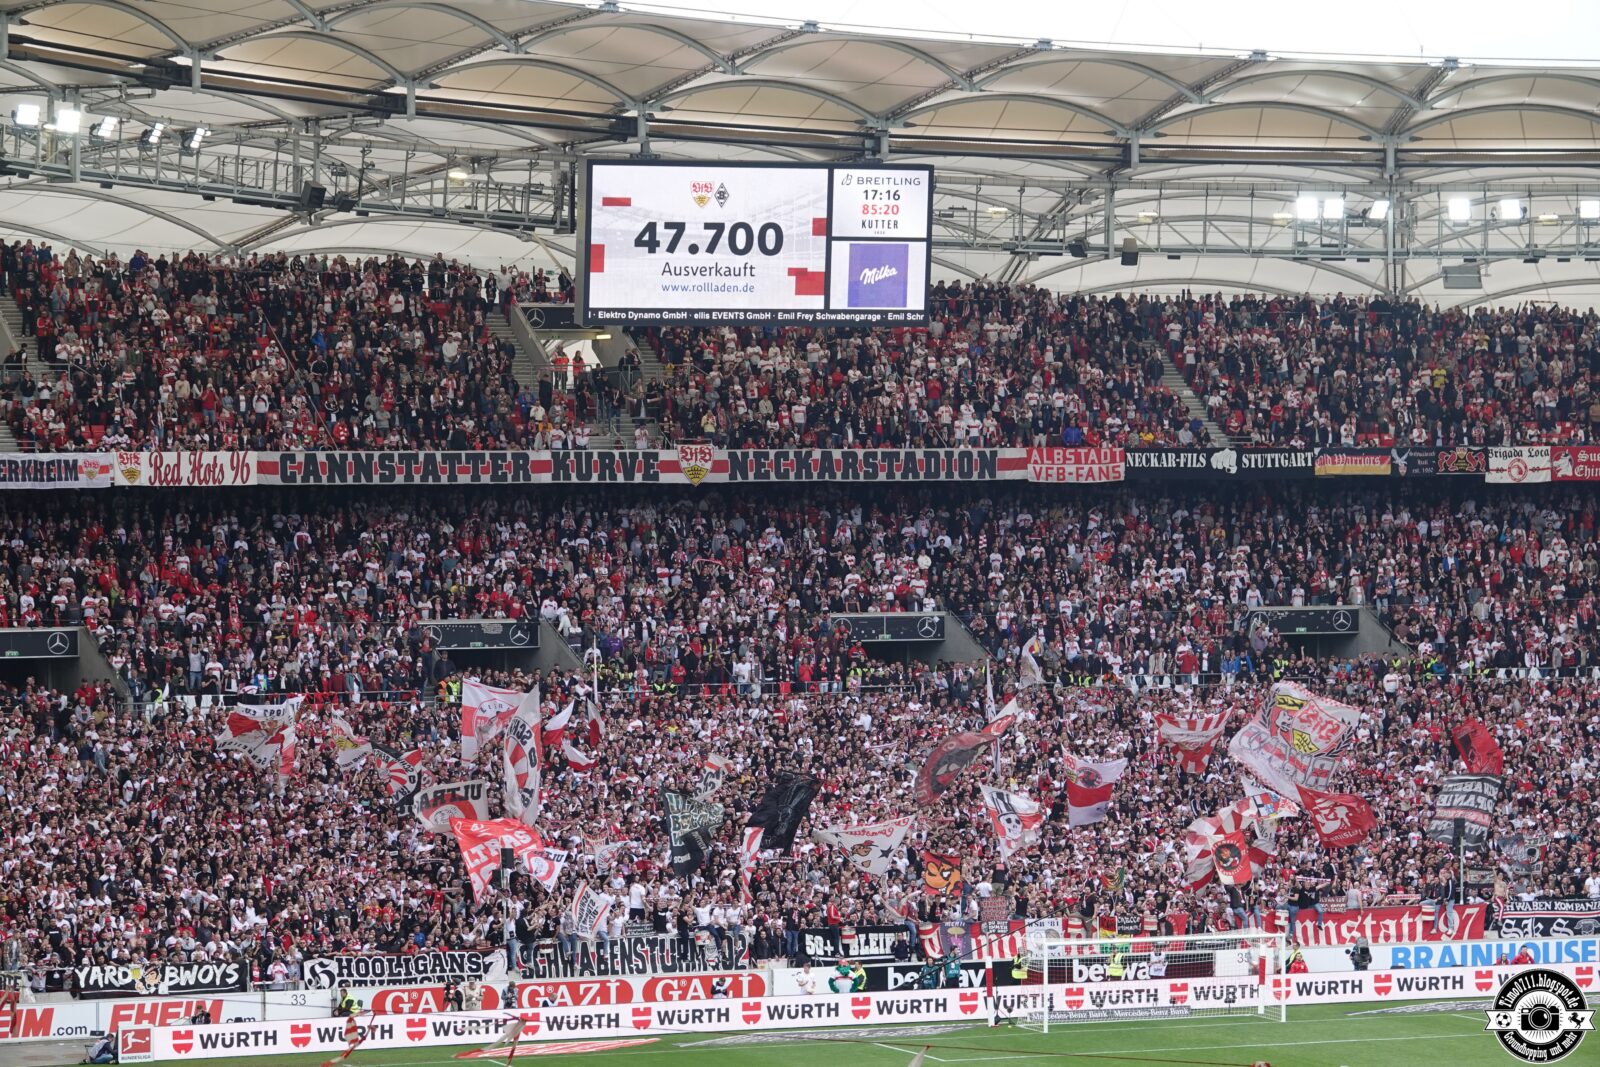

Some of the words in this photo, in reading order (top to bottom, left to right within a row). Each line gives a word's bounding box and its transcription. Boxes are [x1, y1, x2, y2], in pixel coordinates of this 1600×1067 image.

[856, 176, 921, 186] BREITLING
[863, 190, 901, 200] 17:16
[862, 204, 900, 215] 85:20
[862, 220, 898, 229] KUTTER
[634, 221, 784, 256] 47.700
[661, 262, 756, 278] Ausverkauft
[860, 266, 898, 284] Milka
[661, 282, 755, 293] www.rollladen.de
[598, 311, 626, 319] Elektro
[628, 311, 660, 320] Dynamo
[712, 312, 745, 320] EVENTS
[746, 312, 771, 320] GmbH
[796, 312, 813, 321] Frey
[816, 312, 881, 321] Schwabengarage
[1029, 448, 1122, 465] ALBSTADT
[1126, 452, 1206, 468] NECKAR-FILS
[1242, 451, 1314, 469] STUTTGART
[1334, 453, 1381, 466] Warriors
[1488, 448, 1523, 460] Brigada
[1528, 448, 1550, 458] Loca
[149, 450, 182, 486] Red
[190, 451, 225, 485] Hots
[230, 450, 250, 485] 96
[279, 452, 532, 483] CANNSTATTER
[551, 452, 660, 482] KURVE
[728, 450, 998, 482] NECKARSTADION
[1032, 464, 1122, 482] VFB-FANS
[1492, 901, 1552, 911] SHWABEN
[335, 952, 483, 978] HOOLIGANS
[74, 966, 132, 989] YARD
[164, 963, 240, 987] BWOYS
[1396, 975, 1464, 992] WÜRTH
[1194, 984, 1260, 1001] WÜRTH
[1296, 980, 1363, 996] WÜRTH
[290, 994, 306, 1006] 33
[1089, 988, 1158, 1007] WÜRTH
[767, 1002, 840, 1020] WÜRTH
[876, 998, 948, 1016] WÜRTH
[1114, 1008, 1168, 1017] Mercedes-Benz
[546, 1013, 620, 1031] WÜRTH
[657, 1008, 730, 1026] WÜRTH
[432, 1018, 507, 1037] WÜRTH
[200, 1030, 278, 1050] WÜRTH
